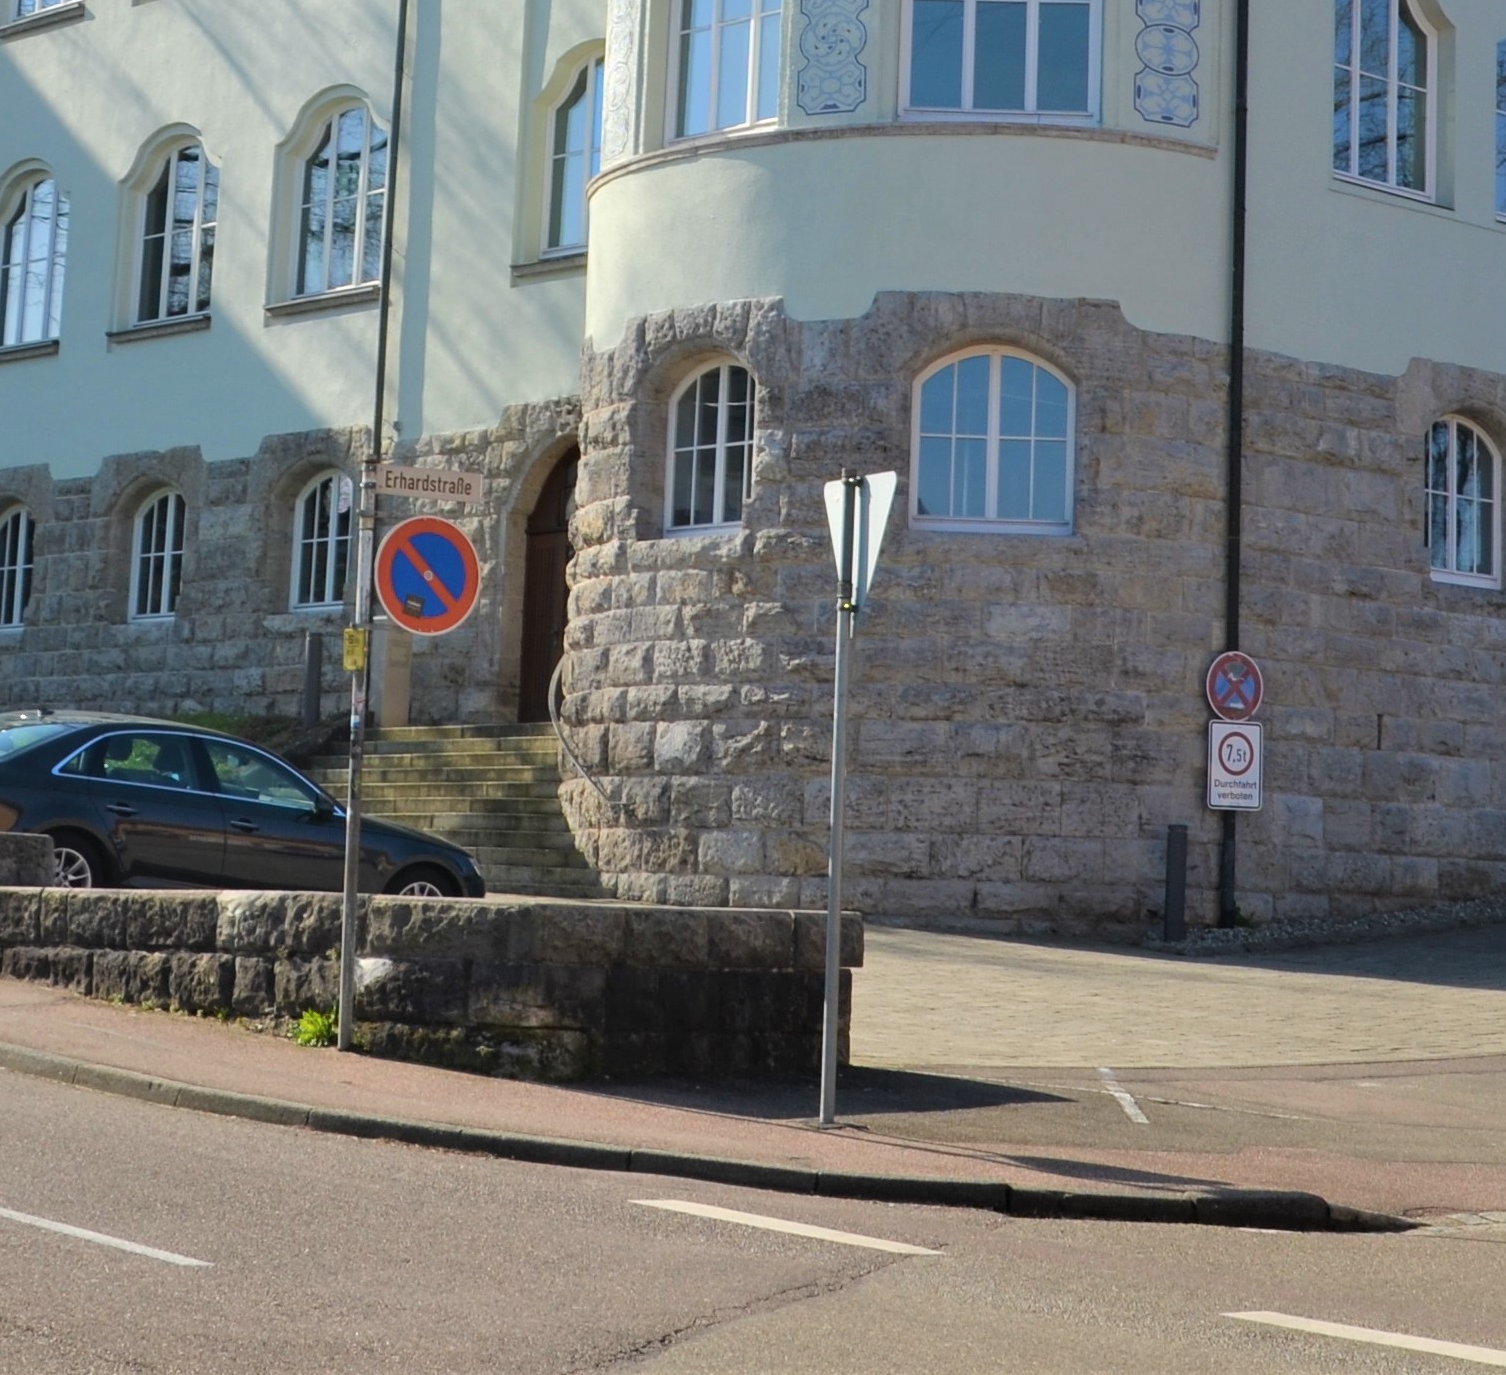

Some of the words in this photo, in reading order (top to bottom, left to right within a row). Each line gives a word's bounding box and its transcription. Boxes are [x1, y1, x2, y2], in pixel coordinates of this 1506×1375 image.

[384, 470, 472, 496] Erhardstraße
[1214, 778, 1257, 790] Durchfahrt
[1217, 791, 1253, 801] verboten
